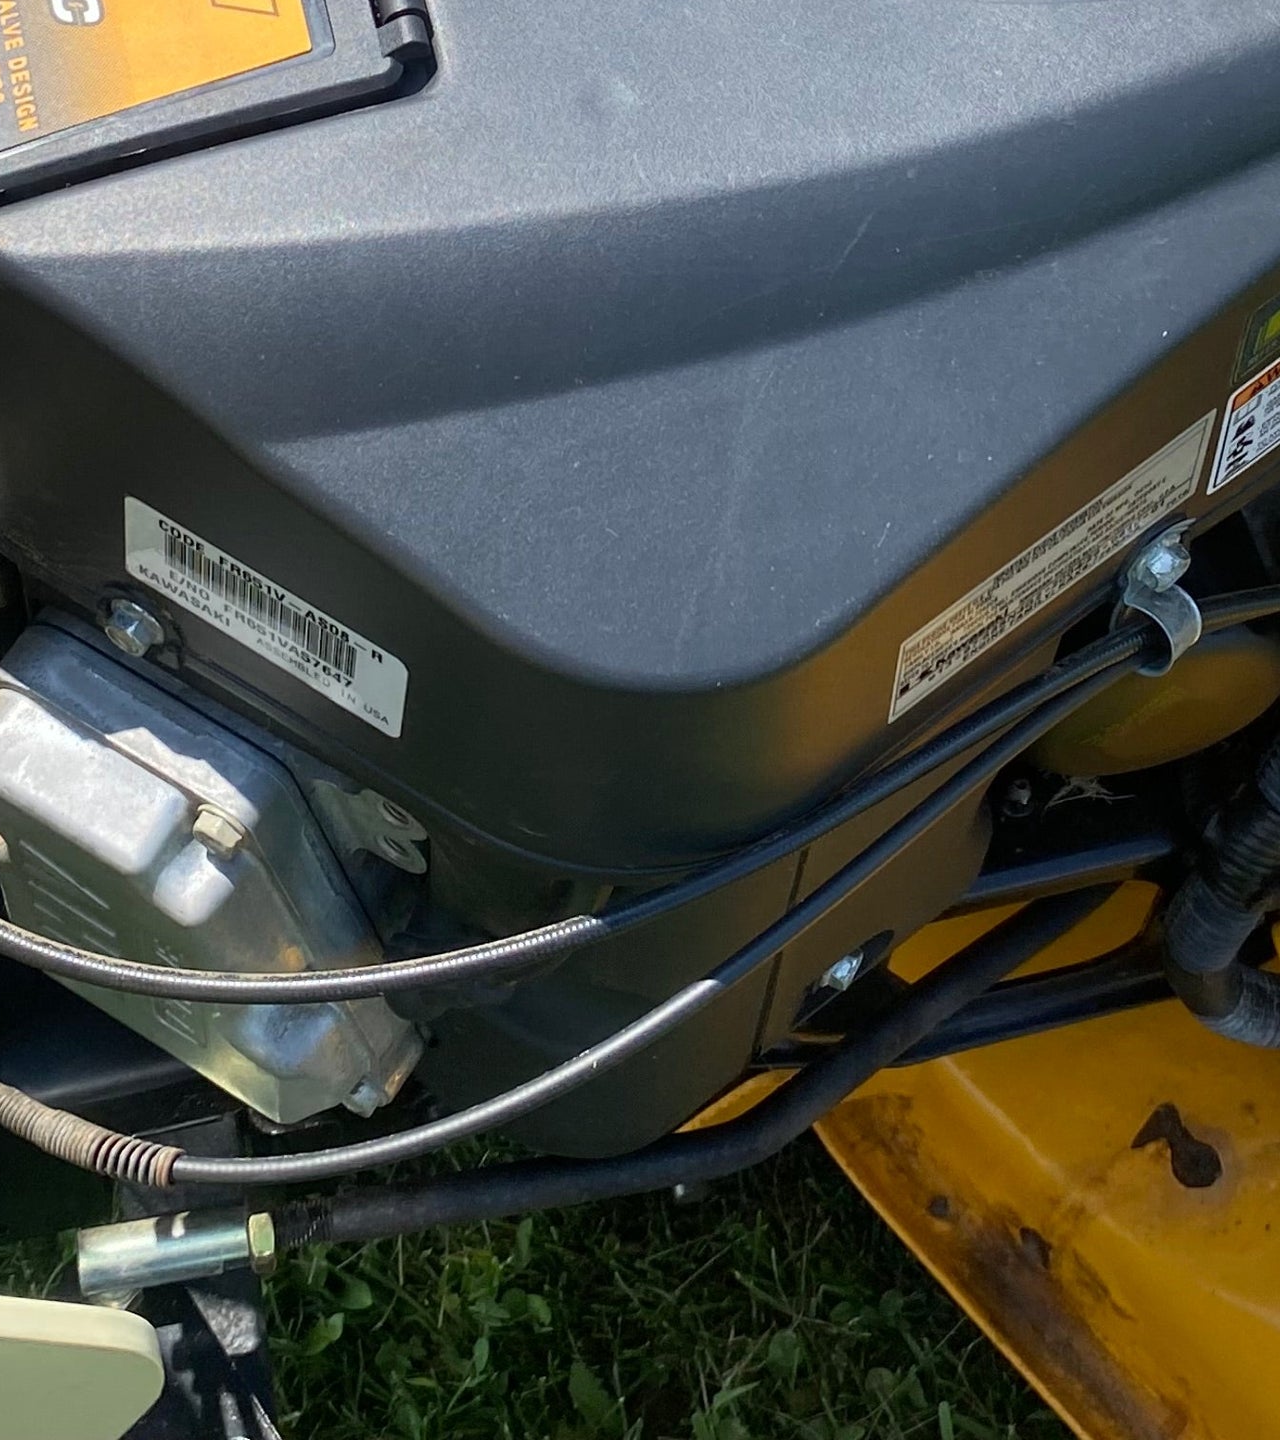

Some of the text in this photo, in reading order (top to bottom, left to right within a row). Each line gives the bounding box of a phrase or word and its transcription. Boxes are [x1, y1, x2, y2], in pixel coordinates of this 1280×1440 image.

[6, 54, 41, 133] DESIGN
[157, 518, 206, 556] CODE
[138, 563, 391, 727] KAWASAKI ASSEMBLED IN USA
[168, 570, 354, 689] E/NO FR651VAS7647
[947, 607, 1009, 660] Kawasaki
